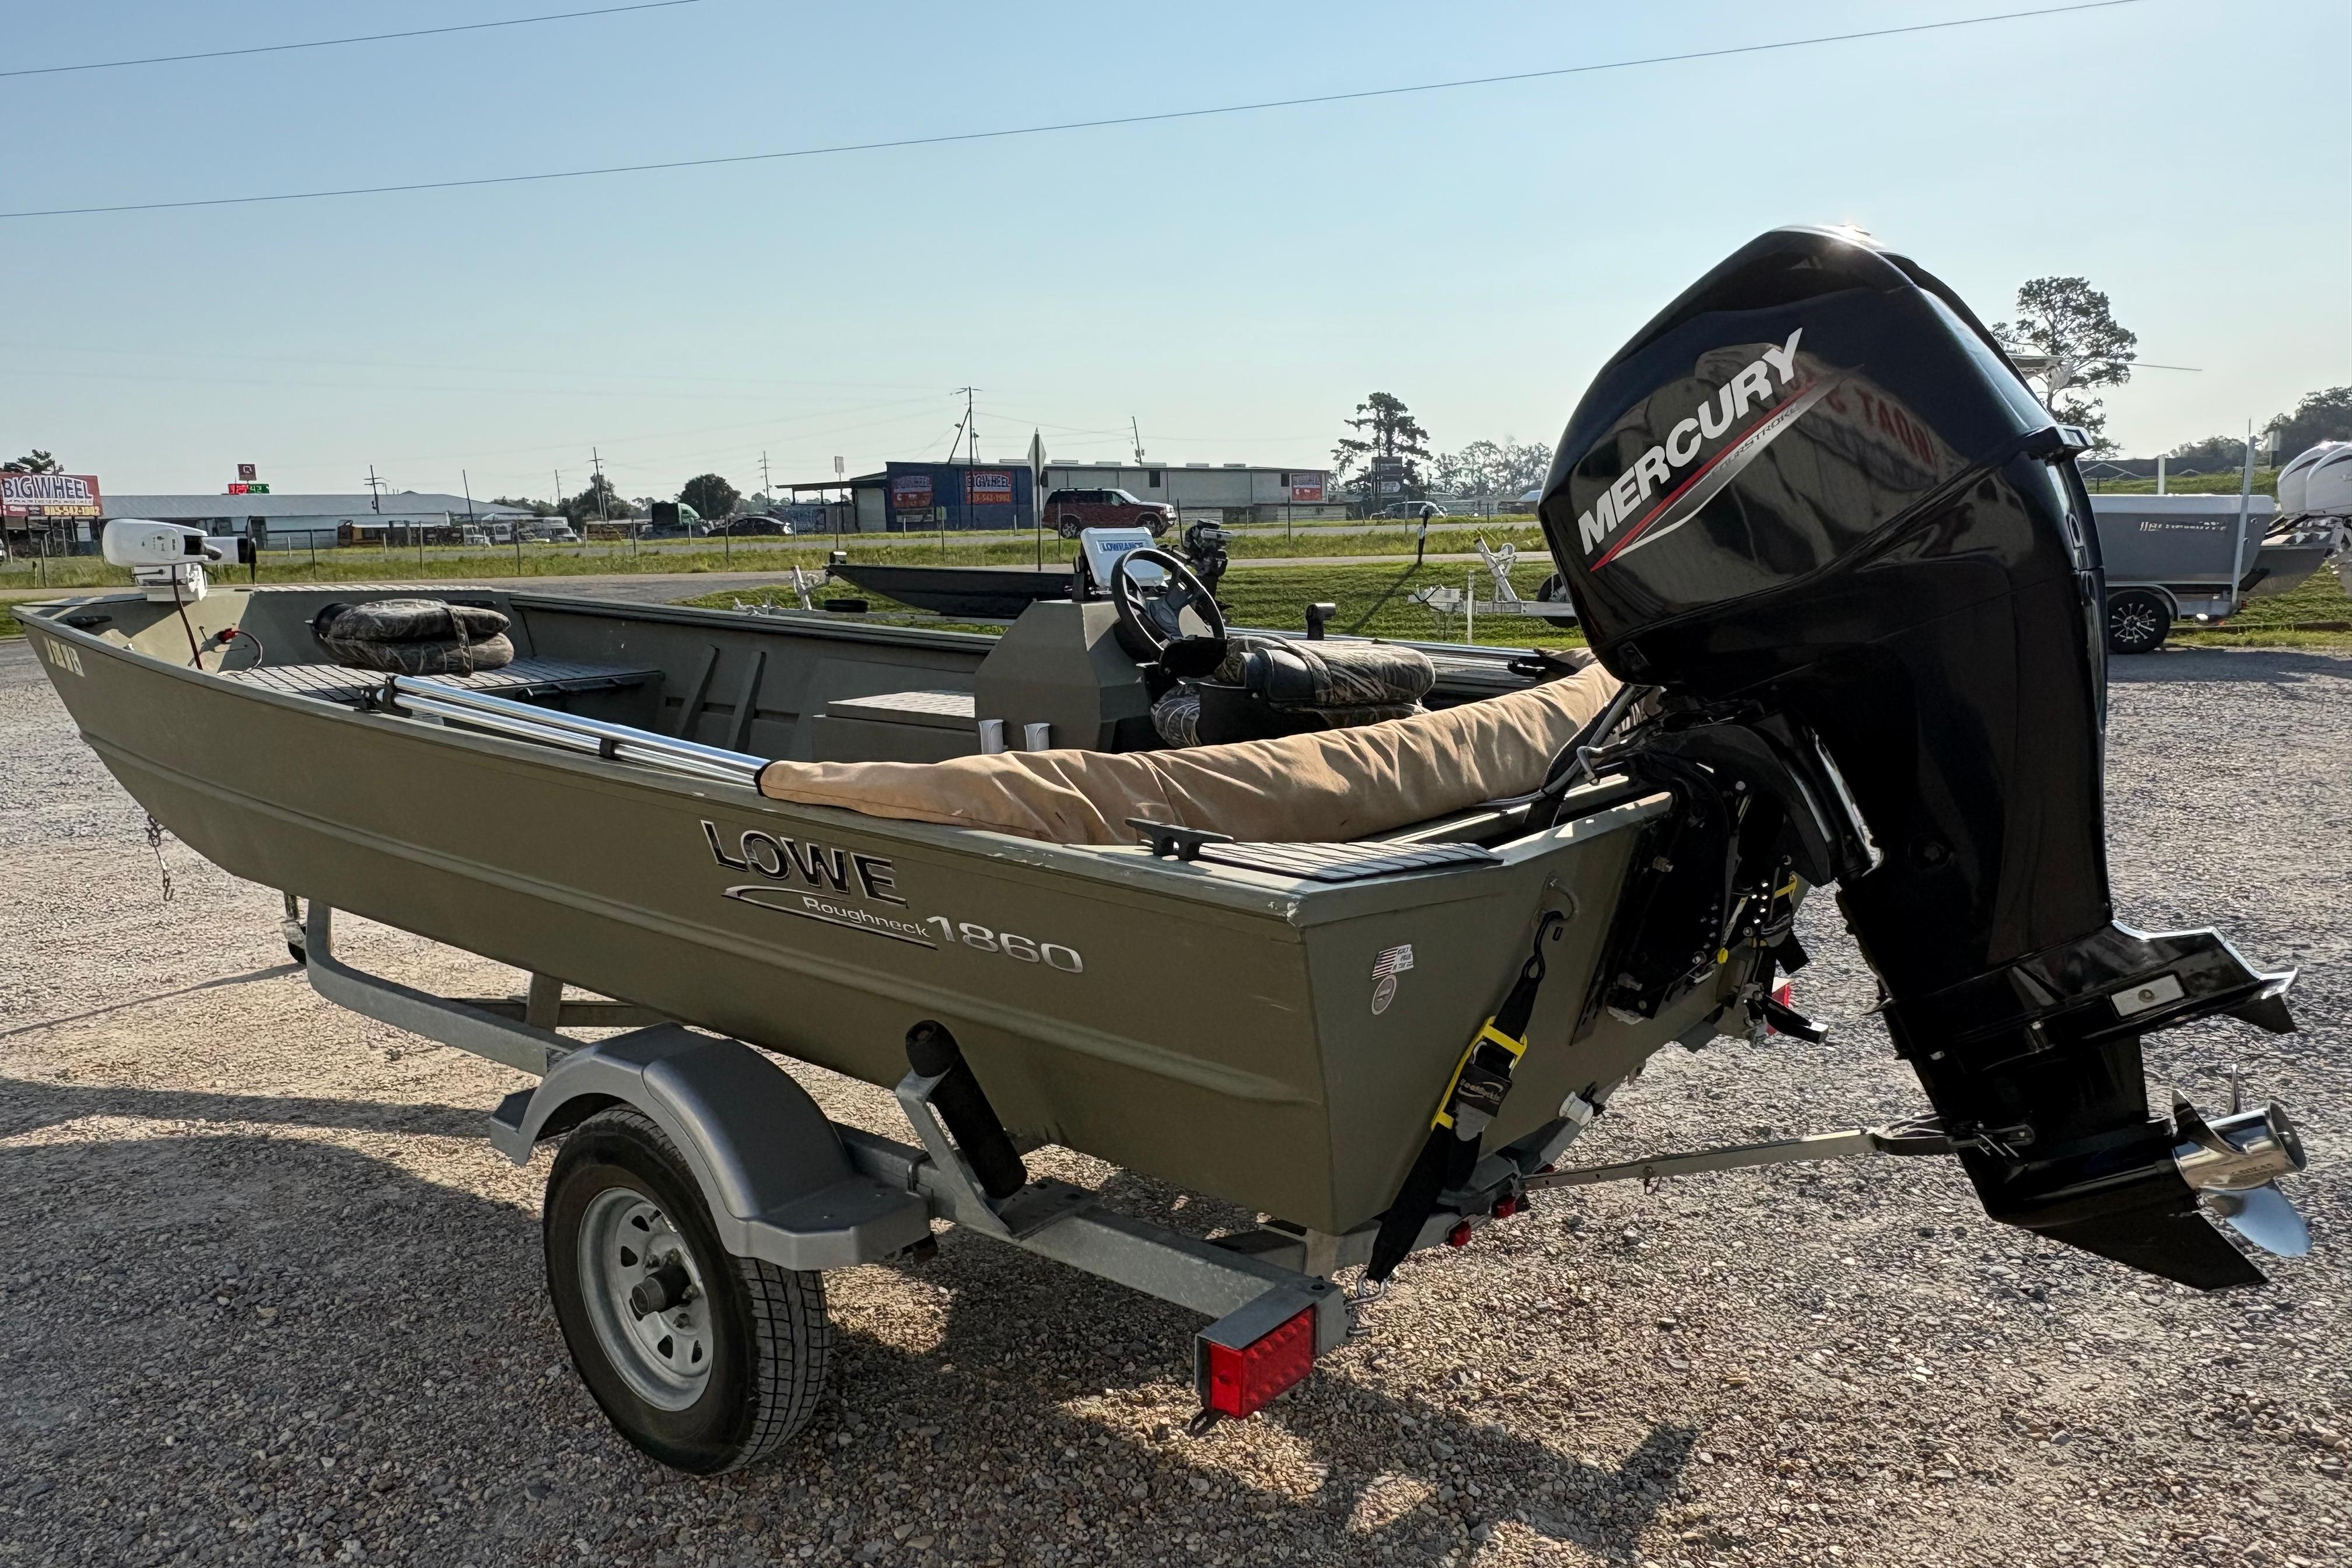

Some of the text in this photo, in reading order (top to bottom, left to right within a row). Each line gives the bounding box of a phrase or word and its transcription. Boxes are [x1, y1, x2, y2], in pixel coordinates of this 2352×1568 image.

[1578, 327, 1803, 555] MERCURY
[700, 819, 908, 908] LOWE
[803, 896, 1083, 974] Roughneck 1860
